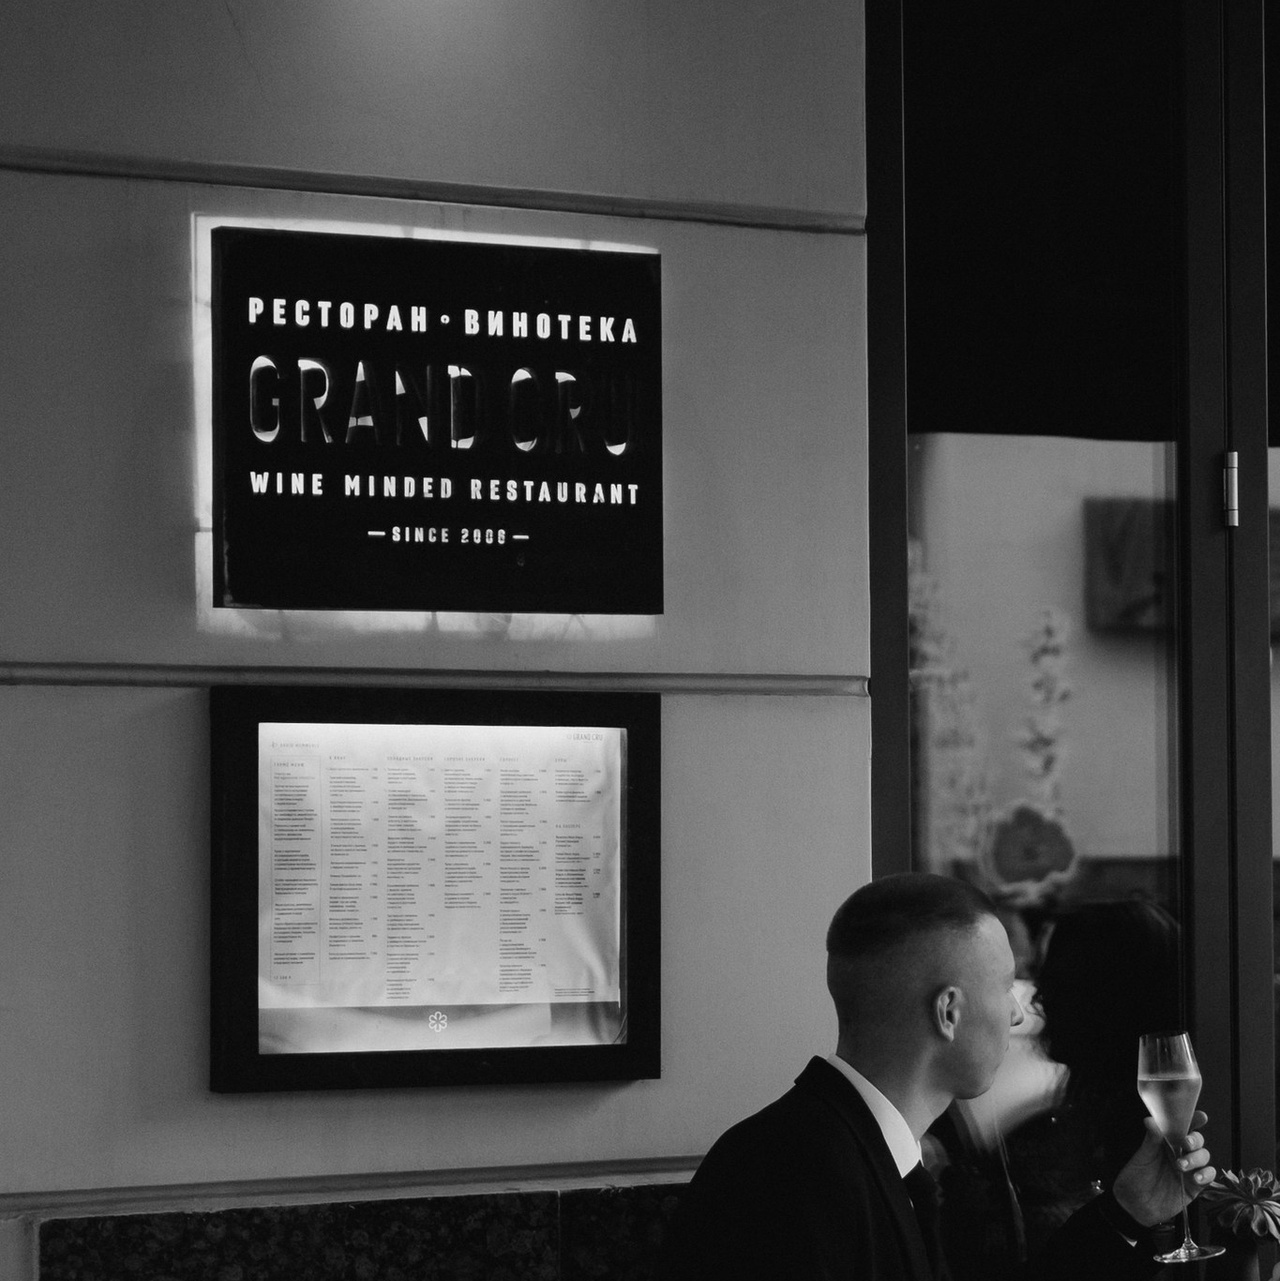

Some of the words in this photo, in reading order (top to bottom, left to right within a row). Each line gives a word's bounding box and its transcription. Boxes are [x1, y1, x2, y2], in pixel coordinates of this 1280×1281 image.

[249, 297, 427, 332] РЕСТОРАН
[464, 309, 637, 343] ВИНОТЕКА
[250, 355, 478, 450] GRAND
[250, 471, 323, 495] WINE
[345, 474, 452, 498] MINDED
[471, 479, 638, 505] RESTAURANT
[392, 526, 449, 543] SINCE
